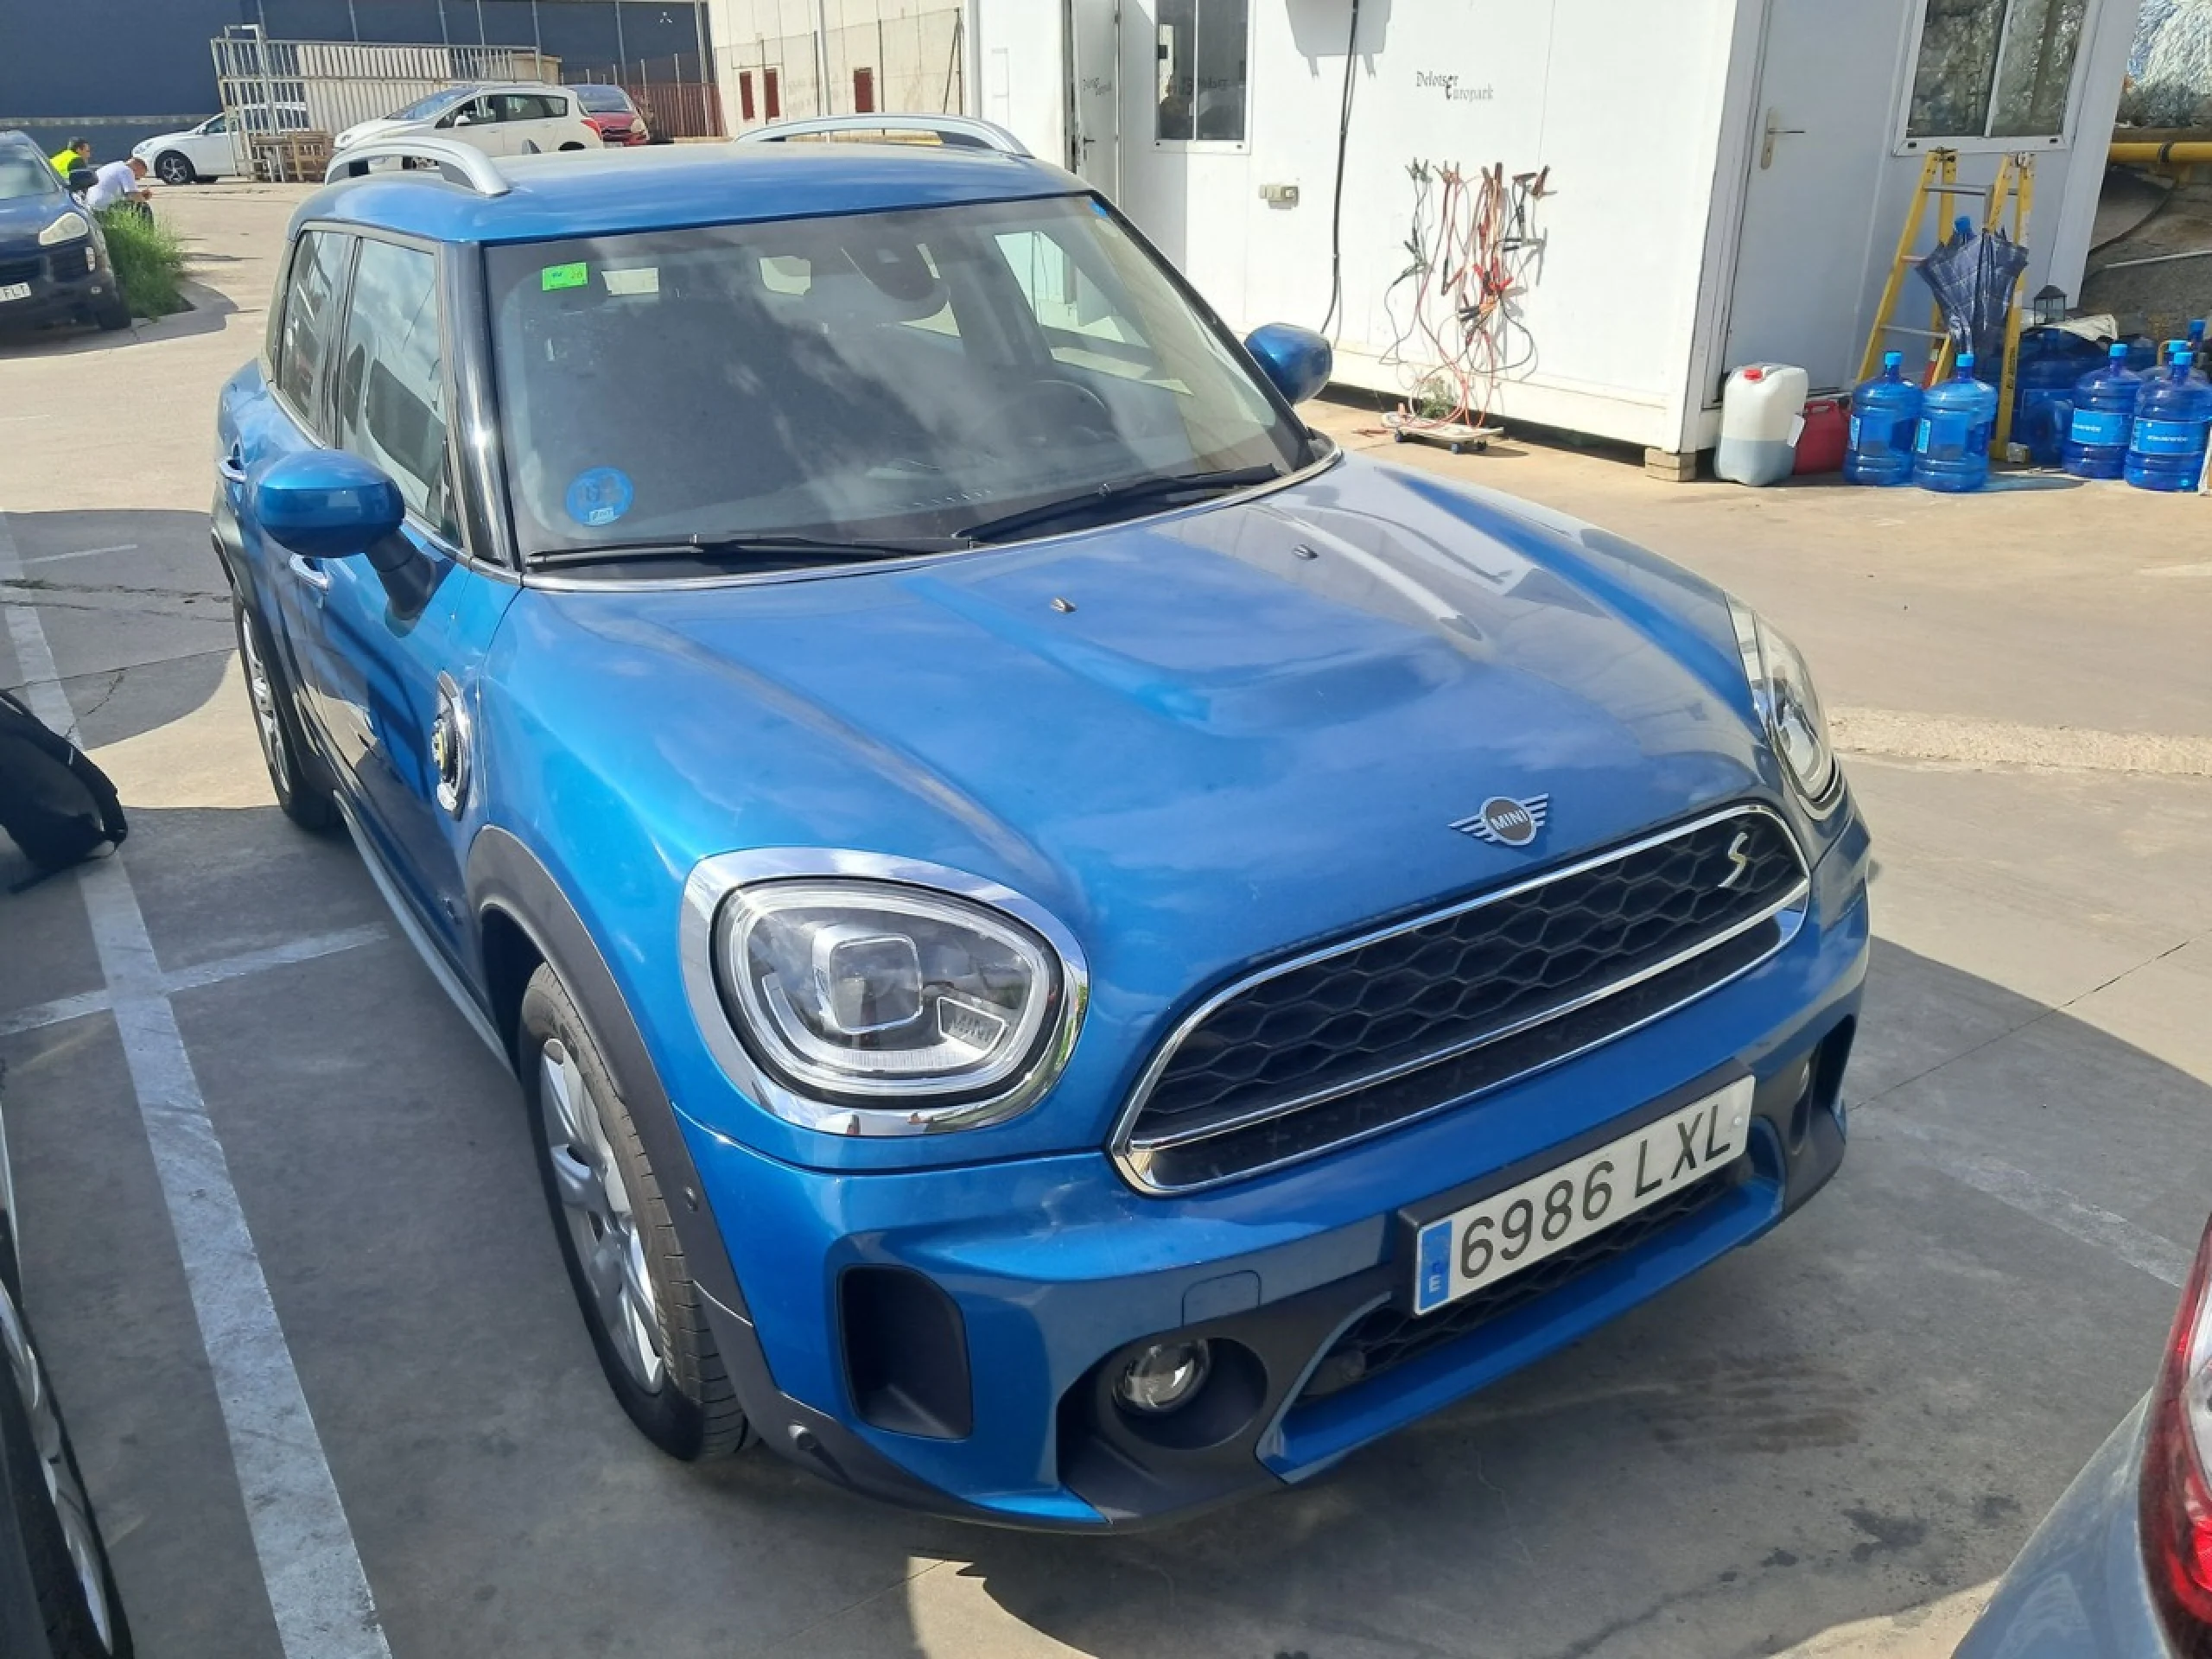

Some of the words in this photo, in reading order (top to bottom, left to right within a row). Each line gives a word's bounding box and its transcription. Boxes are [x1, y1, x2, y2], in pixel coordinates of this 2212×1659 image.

[1491, 810, 1529, 830] MINI
[1459, 1160, 1614, 1280] 6986
[1634, 1104, 1731, 1198] LXL
[1428, 1274, 1440, 1294] E
